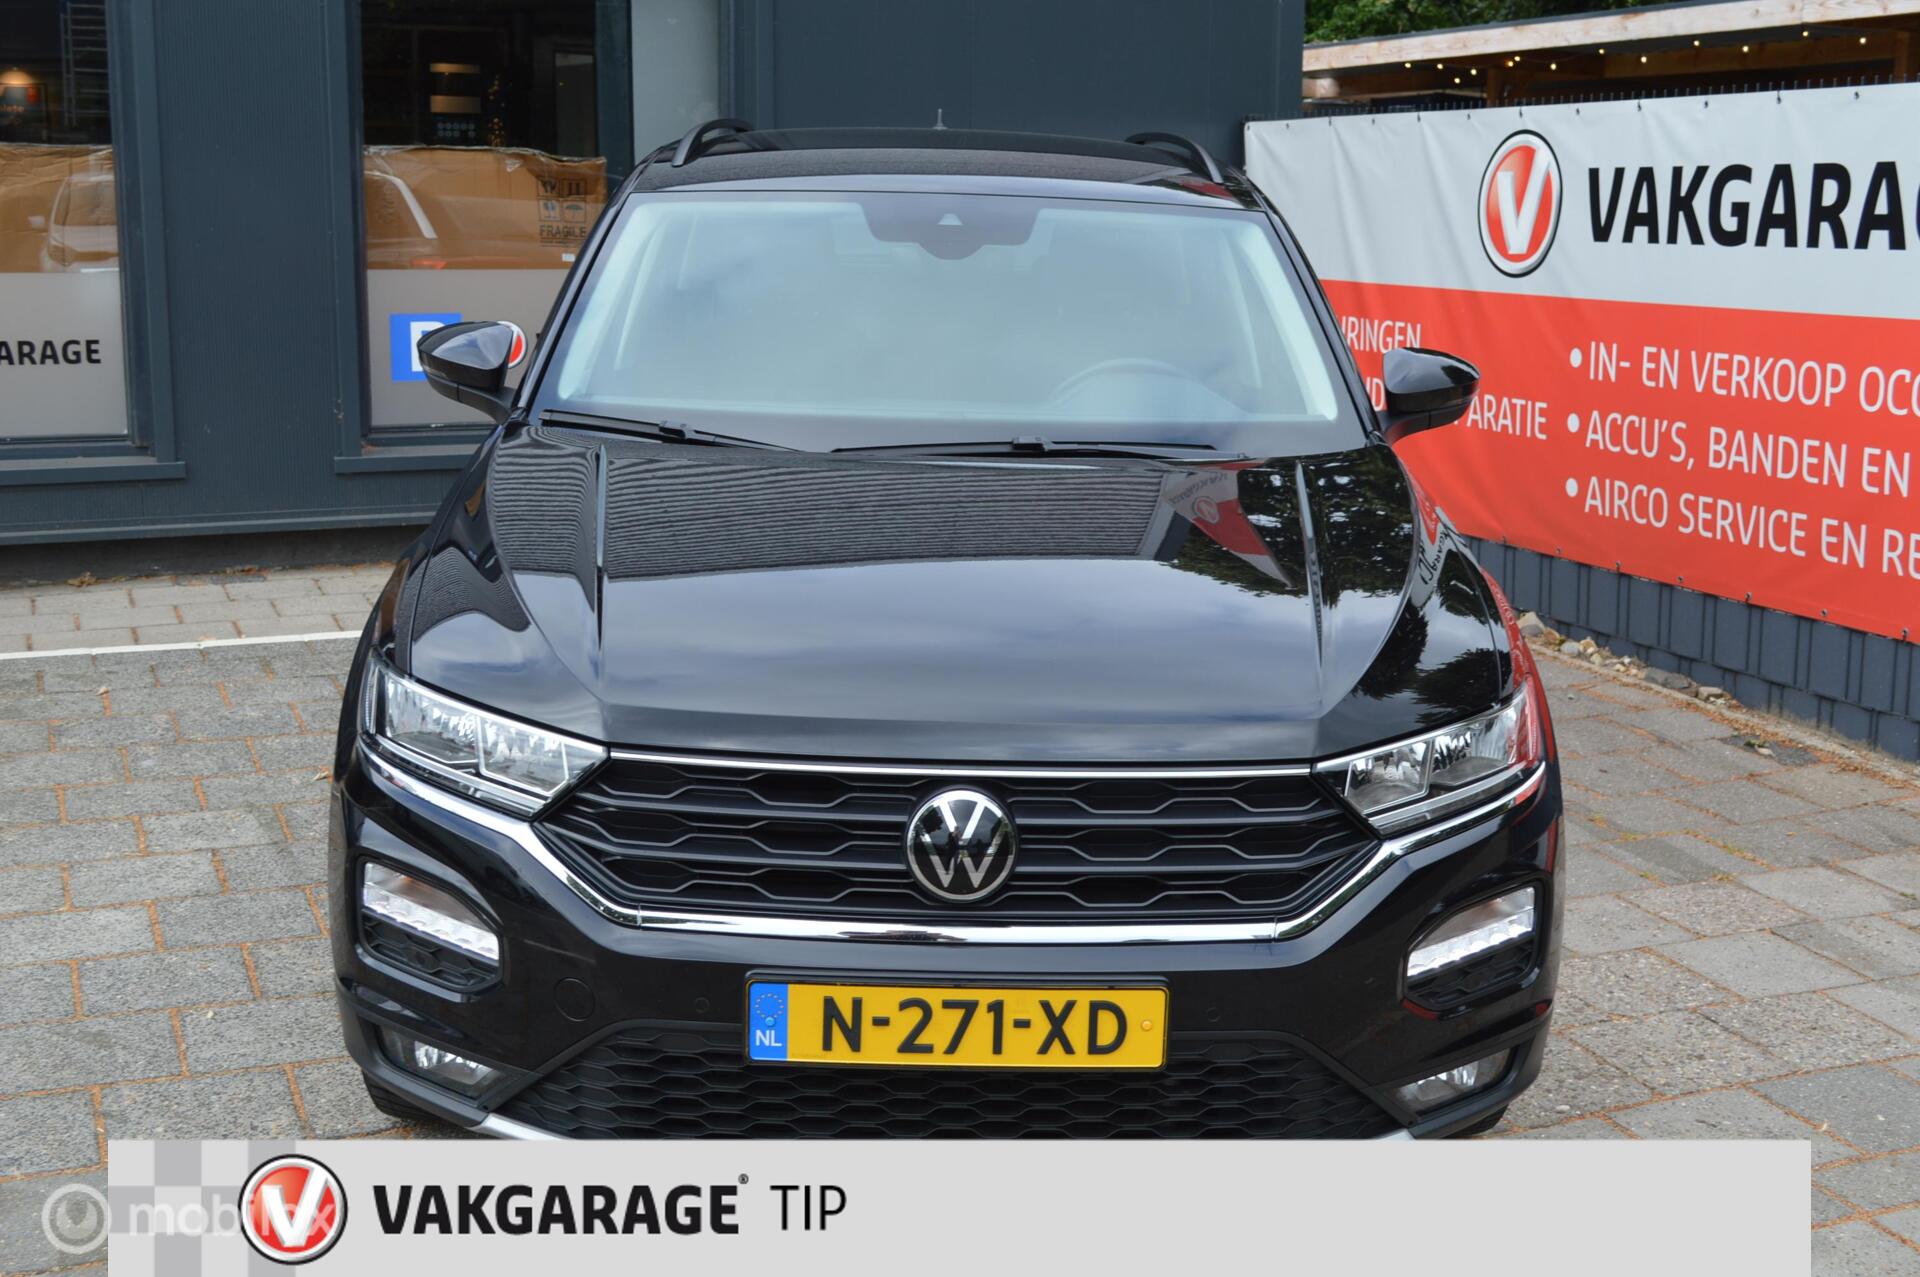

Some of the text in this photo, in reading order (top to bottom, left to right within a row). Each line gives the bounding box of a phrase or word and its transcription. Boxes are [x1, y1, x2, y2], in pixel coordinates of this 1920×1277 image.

[540, 225, 586, 238] FRAGILE
[1588, 161, 1920, 250] VAKGARA
[1341, 316, 1421, 352] RINGEN
[1589, 341, 1631, 382] IN-
[1642, 346, 1680, 389] EN
[1691, 350, 1846, 407] VERKOOP
[1454, 394, 1547, 440] ARATIE
[1585, 410, 1911, 498] ACCU'S, BANDEN EN
[1584, 476, 1668, 528] AIRCO
[1678, 493, 1808, 557] SERVICE
[1820, 518, 1866, 568] EN
[755, 1029, 782, 1047] NL
[822, 995, 1128, 1056] N-271-XD
